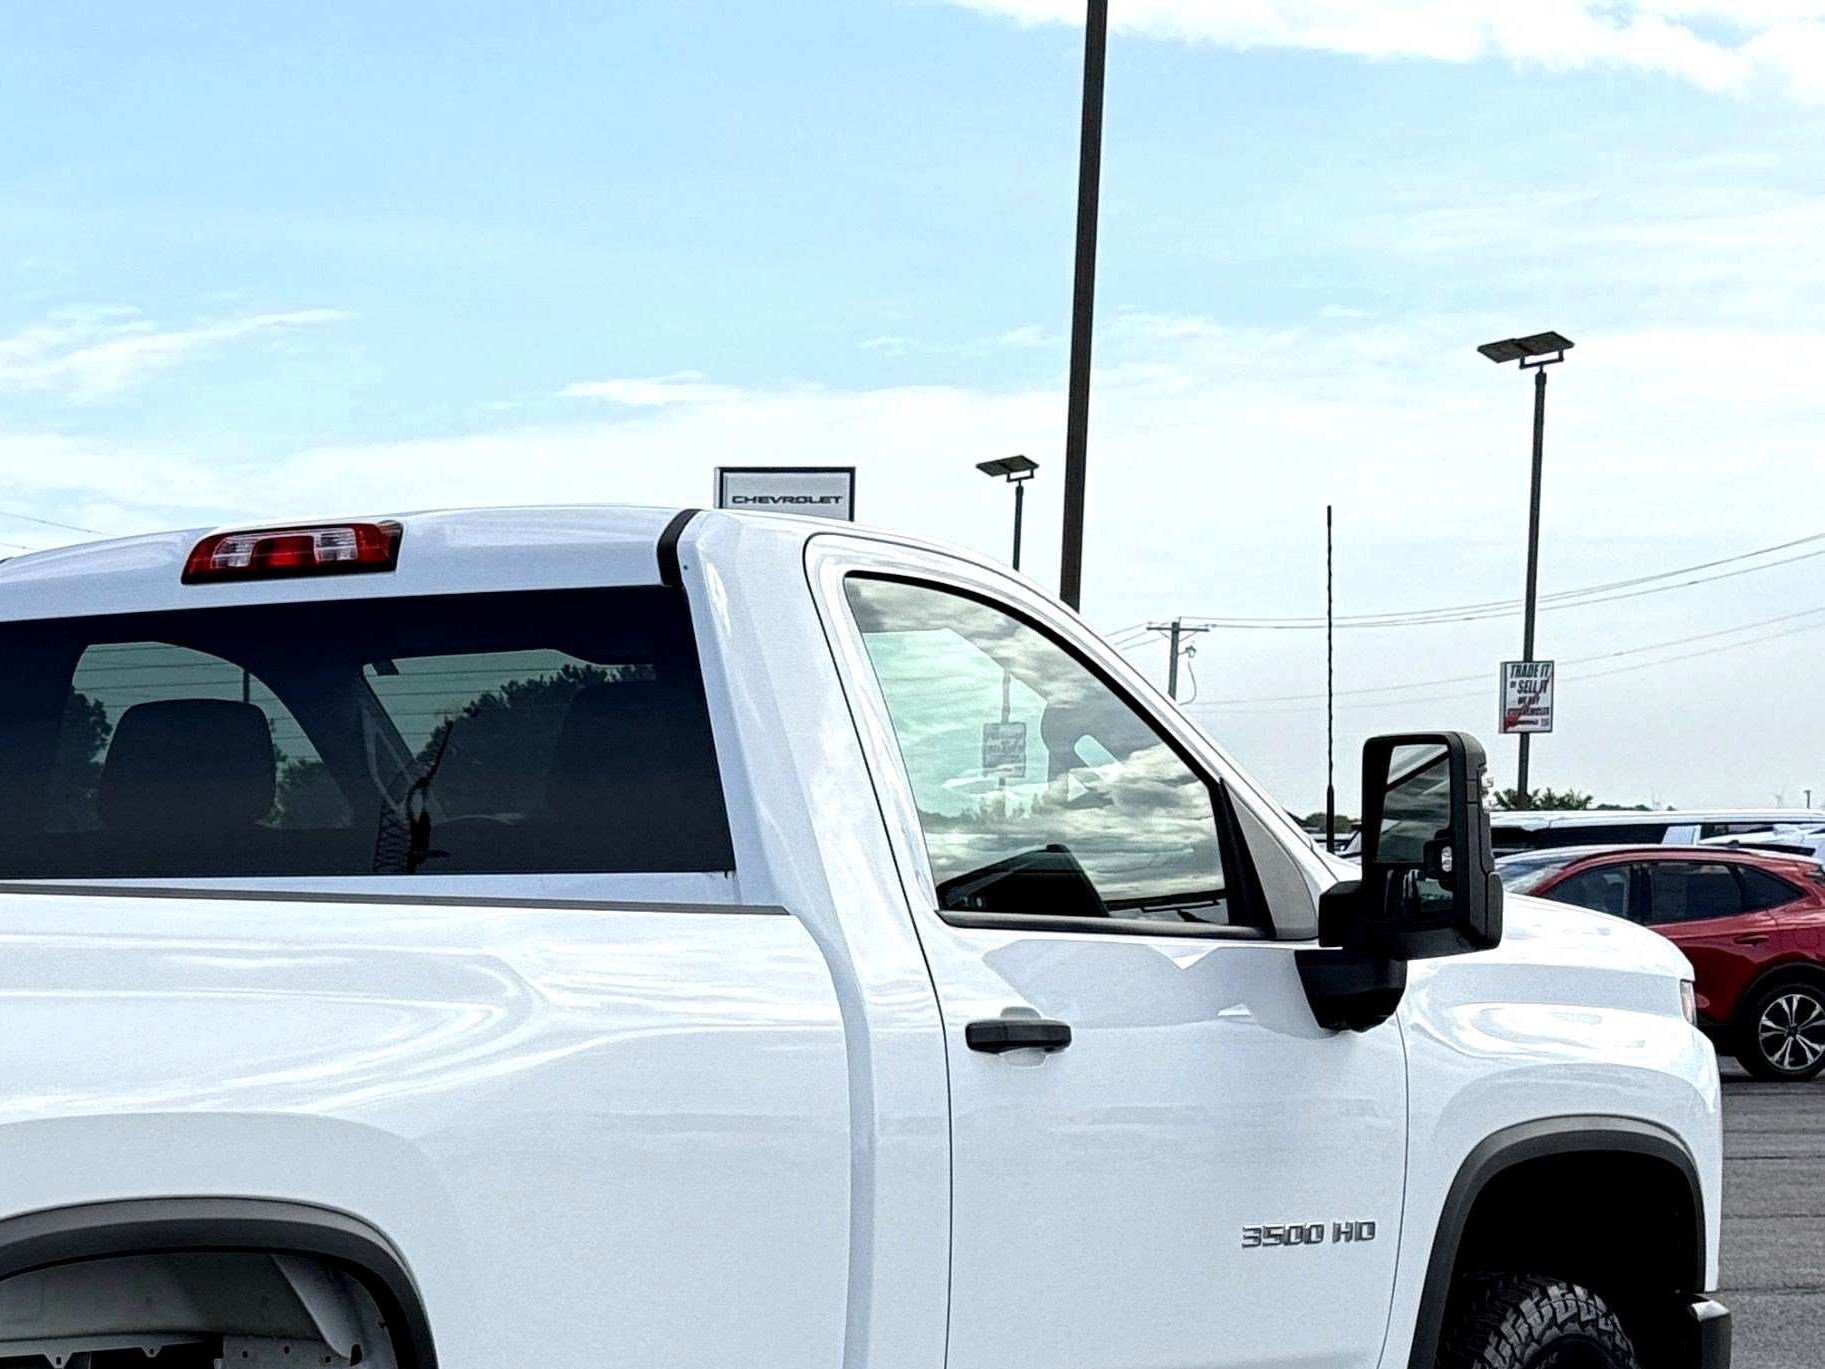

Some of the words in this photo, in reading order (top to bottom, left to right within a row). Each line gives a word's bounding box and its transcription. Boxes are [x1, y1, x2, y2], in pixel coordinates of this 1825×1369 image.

[732, 495, 844, 504] CHEVROLET
[1510, 664, 1539, 678] TRADE
[1540, 664, 1551, 678] IT
[1517, 680, 1538, 694] SELL
[1539, 680, 1549, 693] IT
[1242, 1223, 1325, 1248] 3500
[1332, 1219, 1376, 1244] HD
